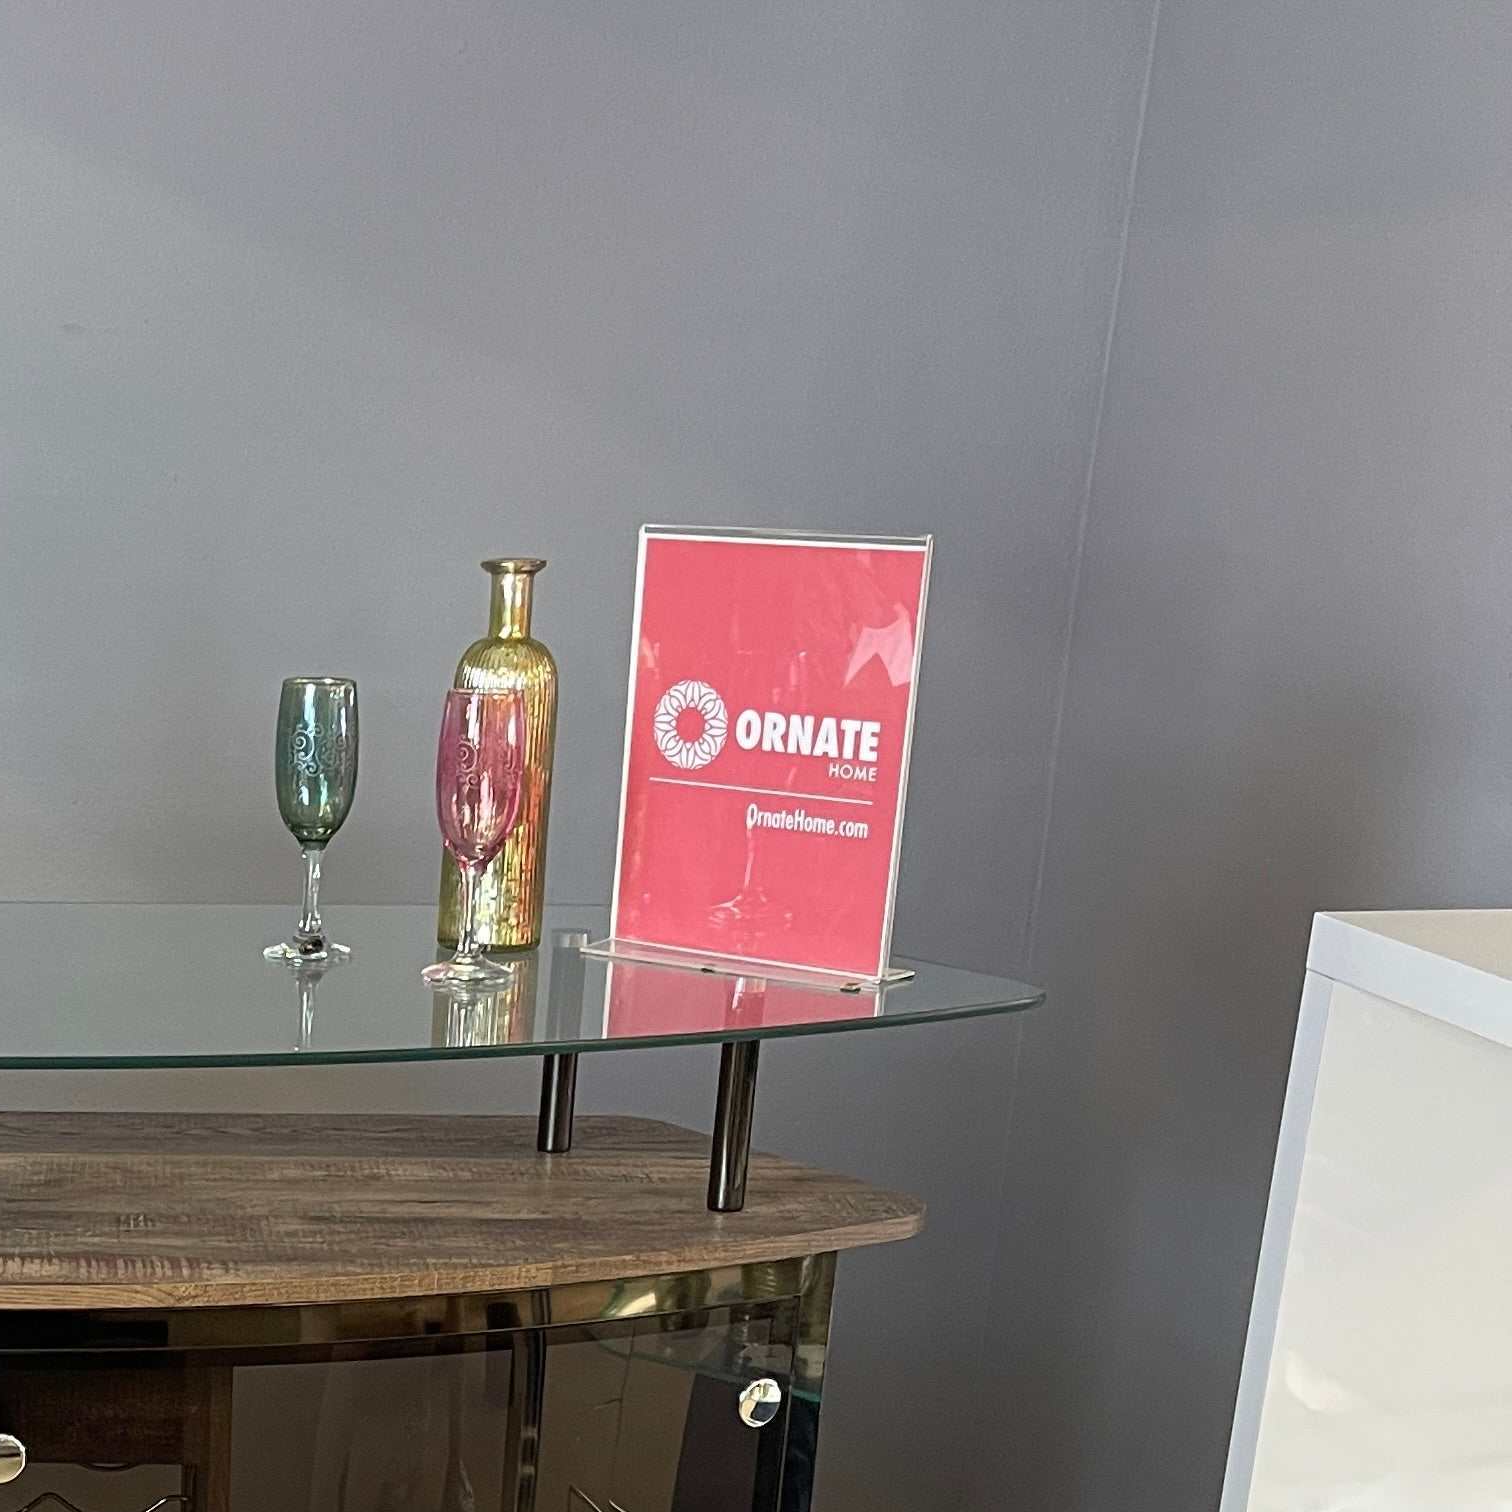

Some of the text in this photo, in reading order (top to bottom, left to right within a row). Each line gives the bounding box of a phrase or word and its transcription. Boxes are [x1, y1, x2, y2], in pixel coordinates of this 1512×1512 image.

[735, 708, 881, 762] ORNATE
[828, 762, 878, 782] HOME
[746, 803, 869, 839] OrnateHome.com
